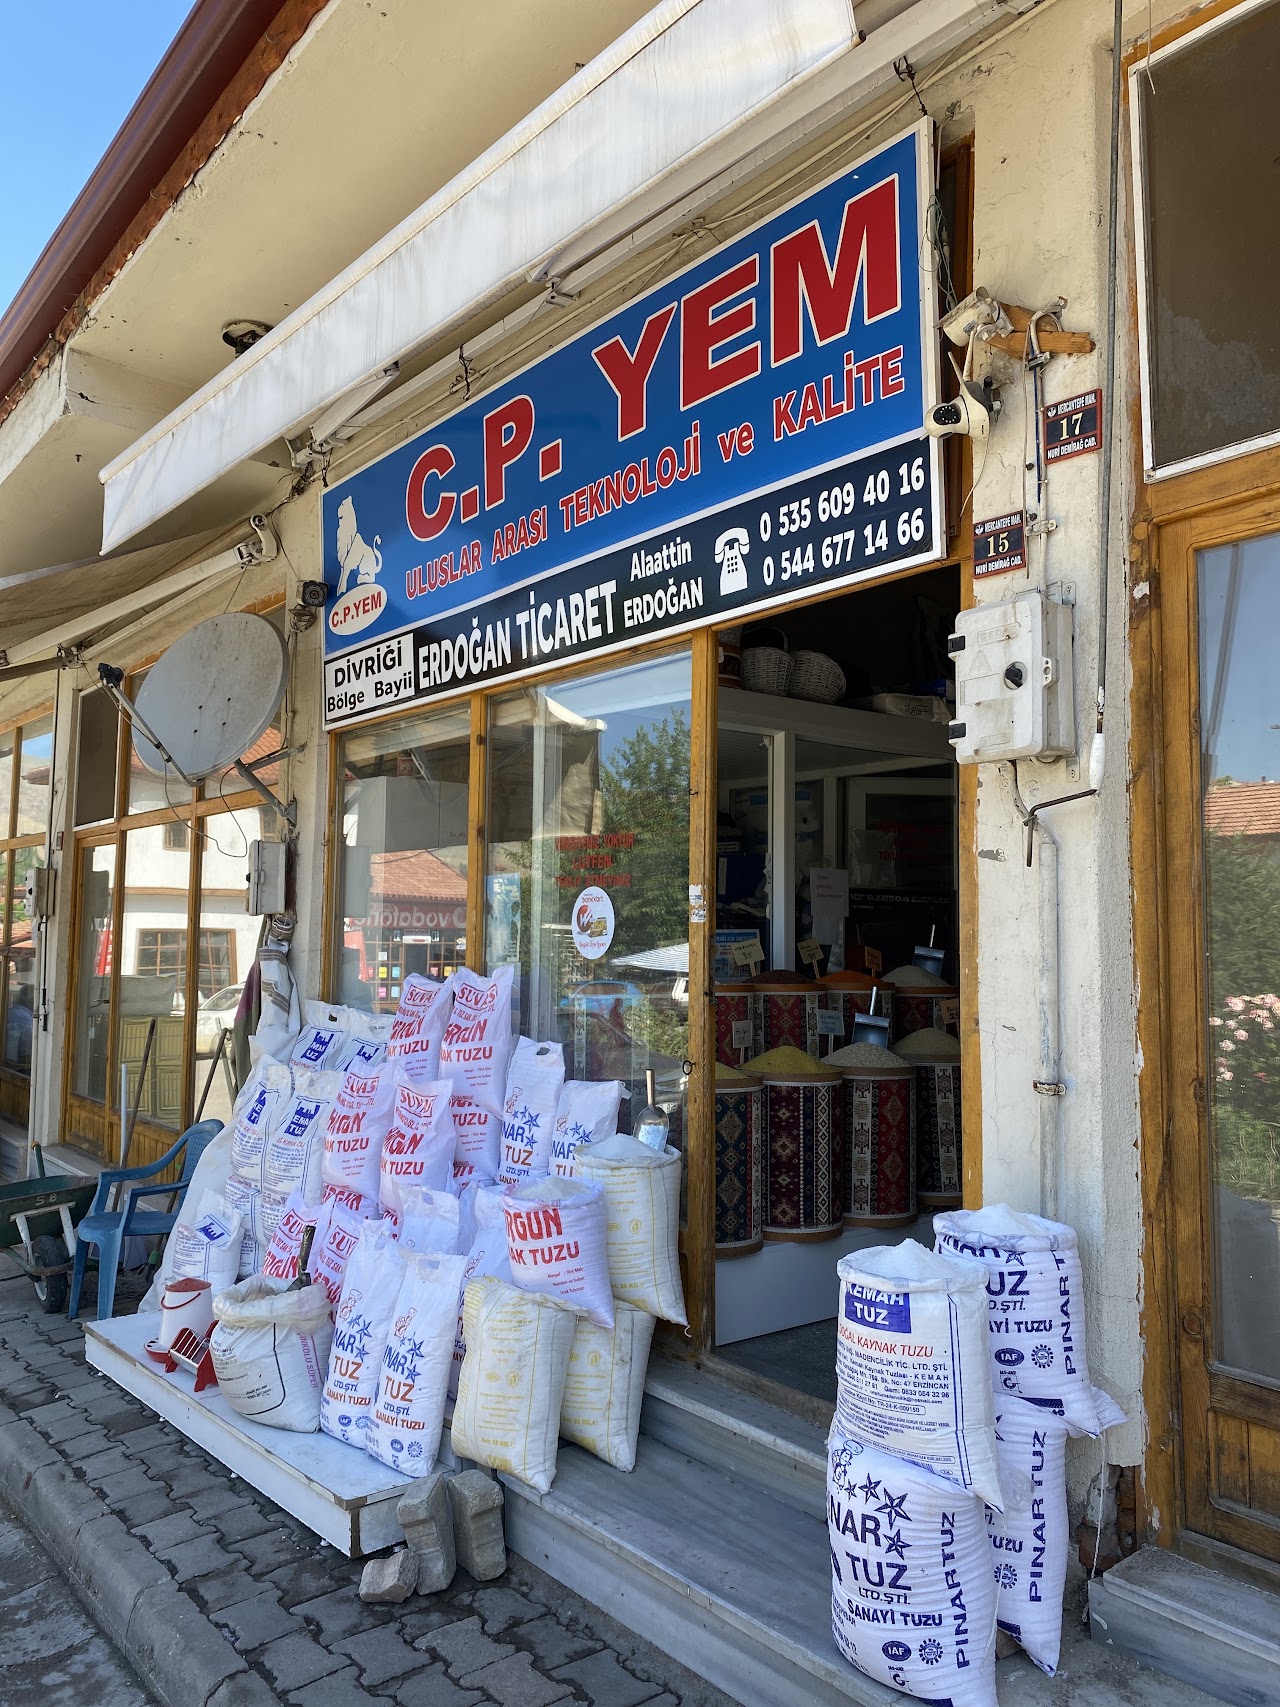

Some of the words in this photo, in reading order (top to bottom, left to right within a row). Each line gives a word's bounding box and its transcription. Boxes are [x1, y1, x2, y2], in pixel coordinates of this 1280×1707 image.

[405, 394, 562, 541] C.P.
[591, 173, 901, 442] YEM
[1060, 412, 1083, 441] 17
[405, 540, 482, 600] ULUSLAR
[491, 505, 547, 564] ARASI
[560, 420, 701, 533] TEKNOLOJİ
[717, 422, 754, 463] ve
[773, 345, 905, 442] KALİTE
[760, 512, 772, 542] 0
[779, 497, 812, 536] 535
[818, 482, 855, 523] 609
[863, 470, 889, 506] 40
[899, 457, 925, 494] 16
[763, 556, 774, 586] 0
[780, 542, 815, 581] 544
[821, 529, 855, 569] 677
[864, 519, 888, 556] 14
[897, 507, 925, 545] 66
[987, 531, 1009, 557] 15
[630, 536, 692, 581] Alaattin
[331, 591, 382, 628] C.P.YEM
[623, 576, 704, 628] ERDOĞAN
[419, 616, 511, 690] ERDOĞAN
[516, 580, 617, 659] TİCARET
[334, 640, 402, 688] DİVRİĞİ
[327, 690, 365, 713] Bölge
[374, 675, 412, 699] Bayii
[398, 1039, 430, 1056] TUZU
[456, 1046, 493, 1062] TUZU
[452, 1112, 489, 1127] TUZU
[337, 1137, 369, 1153] TUZU
[505, 1145, 534, 1166] TUZ
[390, 1161, 424, 1176] TUZU
[529, 1240, 580, 1266] TUZU
[853, 1302, 889, 1325] TUZ
[1014, 1319, 1053, 1333] TUZU
[1059, 1276, 1076, 1375] PINAR
[857, 1335, 897, 1355] KAYNAK
[900, 1344, 934, 1357] TUZU
[1001, 1353, 1018, 1361] IAF
[333, 1355, 363, 1380] TUZ
[855, 1350, 894, 1367] MADENCİLİK
[912, 1362, 931, 1371] LTD.
[932, 1361, 948, 1373] ŞTİ.
[384, 1375, 415, 1402] TUZ
[912, 1379, 949, 1389] ERZİNCAN
[348, 1395, 371, 1406] TUZU
[400, 1419, 425, 1430] TUZU
[940, 1512, 956, 1568] TUZ
[1029, 1498, 1046, 1602] PINAR
[845, 1551, 912, 1591] TUZ
[847, 1599, 895, 1625] SANAYİ
[900, 1613, 943, 1626] TUZU
[950, 1568, 970, 1669] PINAR
